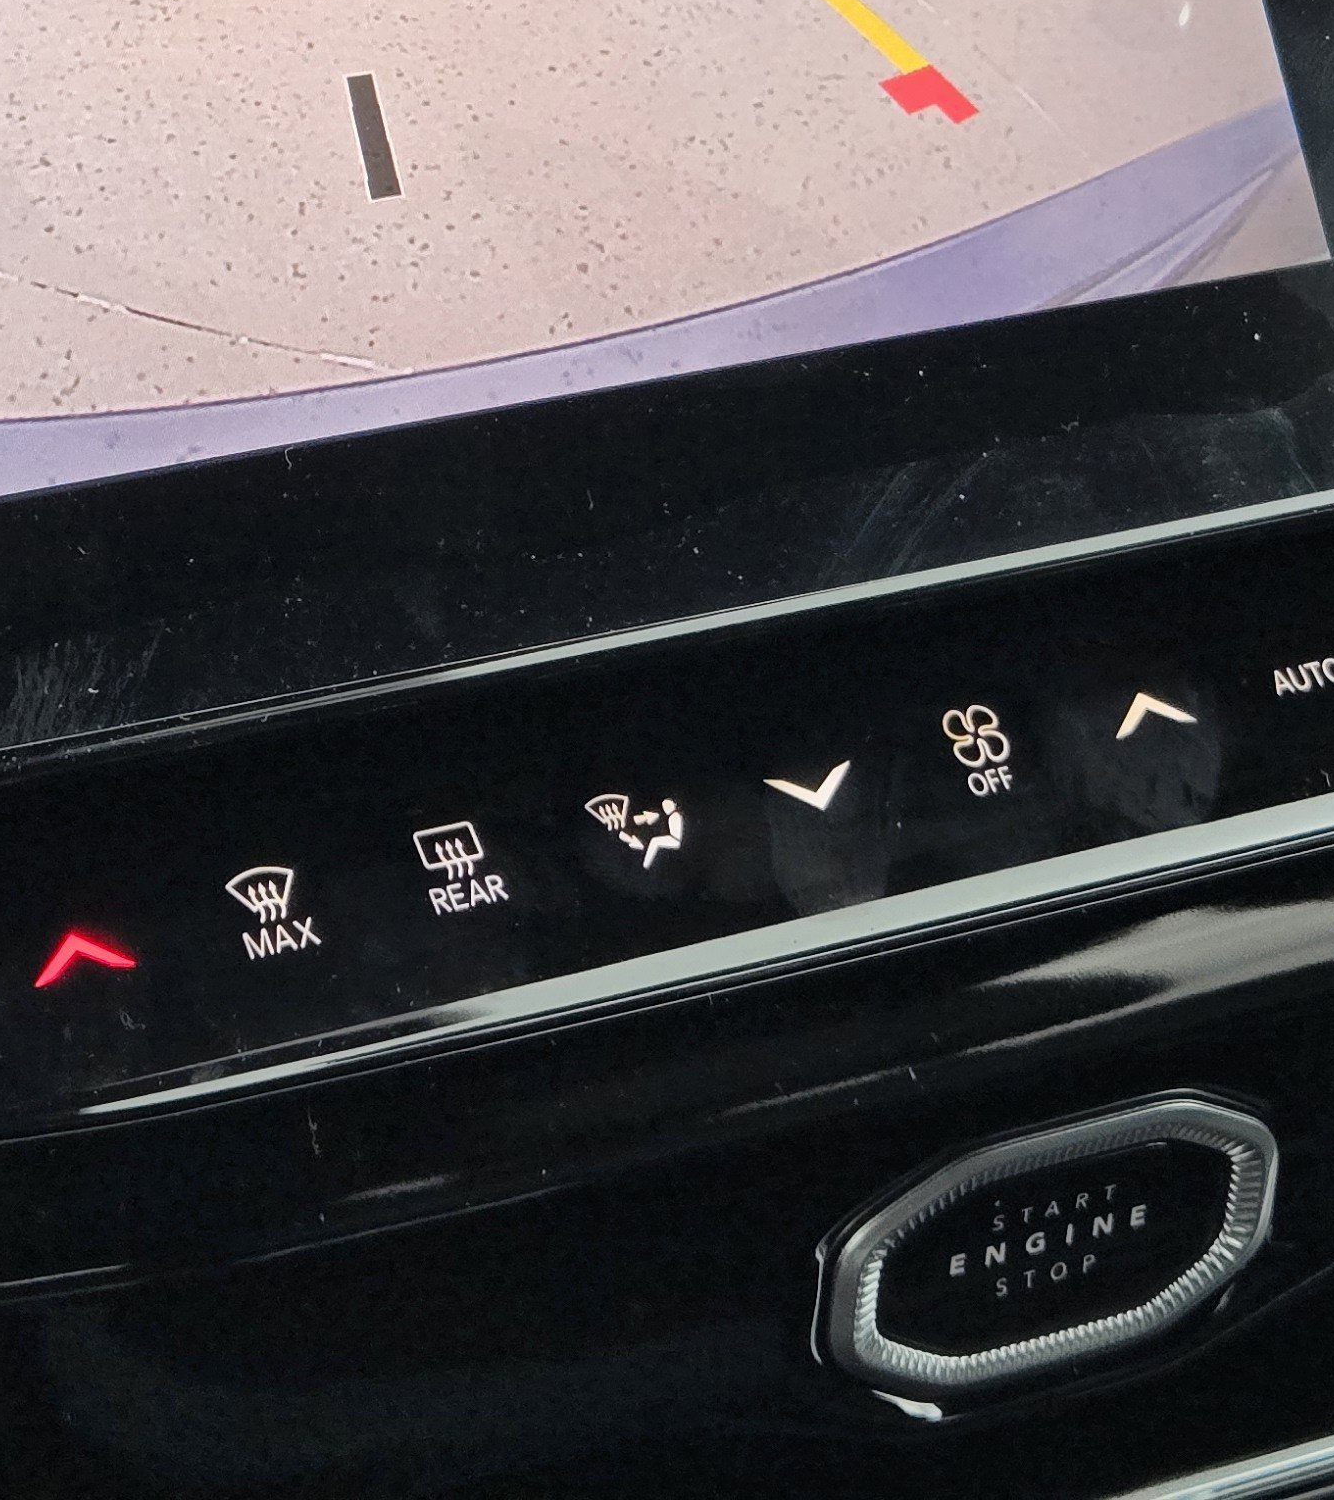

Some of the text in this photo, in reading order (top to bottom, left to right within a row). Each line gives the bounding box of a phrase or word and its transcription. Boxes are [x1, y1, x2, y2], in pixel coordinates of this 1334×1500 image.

[967, 765, 1014, 798] OFF
[428, 874, 509, 915] REAR
[242, 916, 322, 960] MAX
[991, 1184, 1117, 1232] START
[949, 1204, 1147, 1277] ENGINE
[995, 1254, 1096, 1298] STOP
